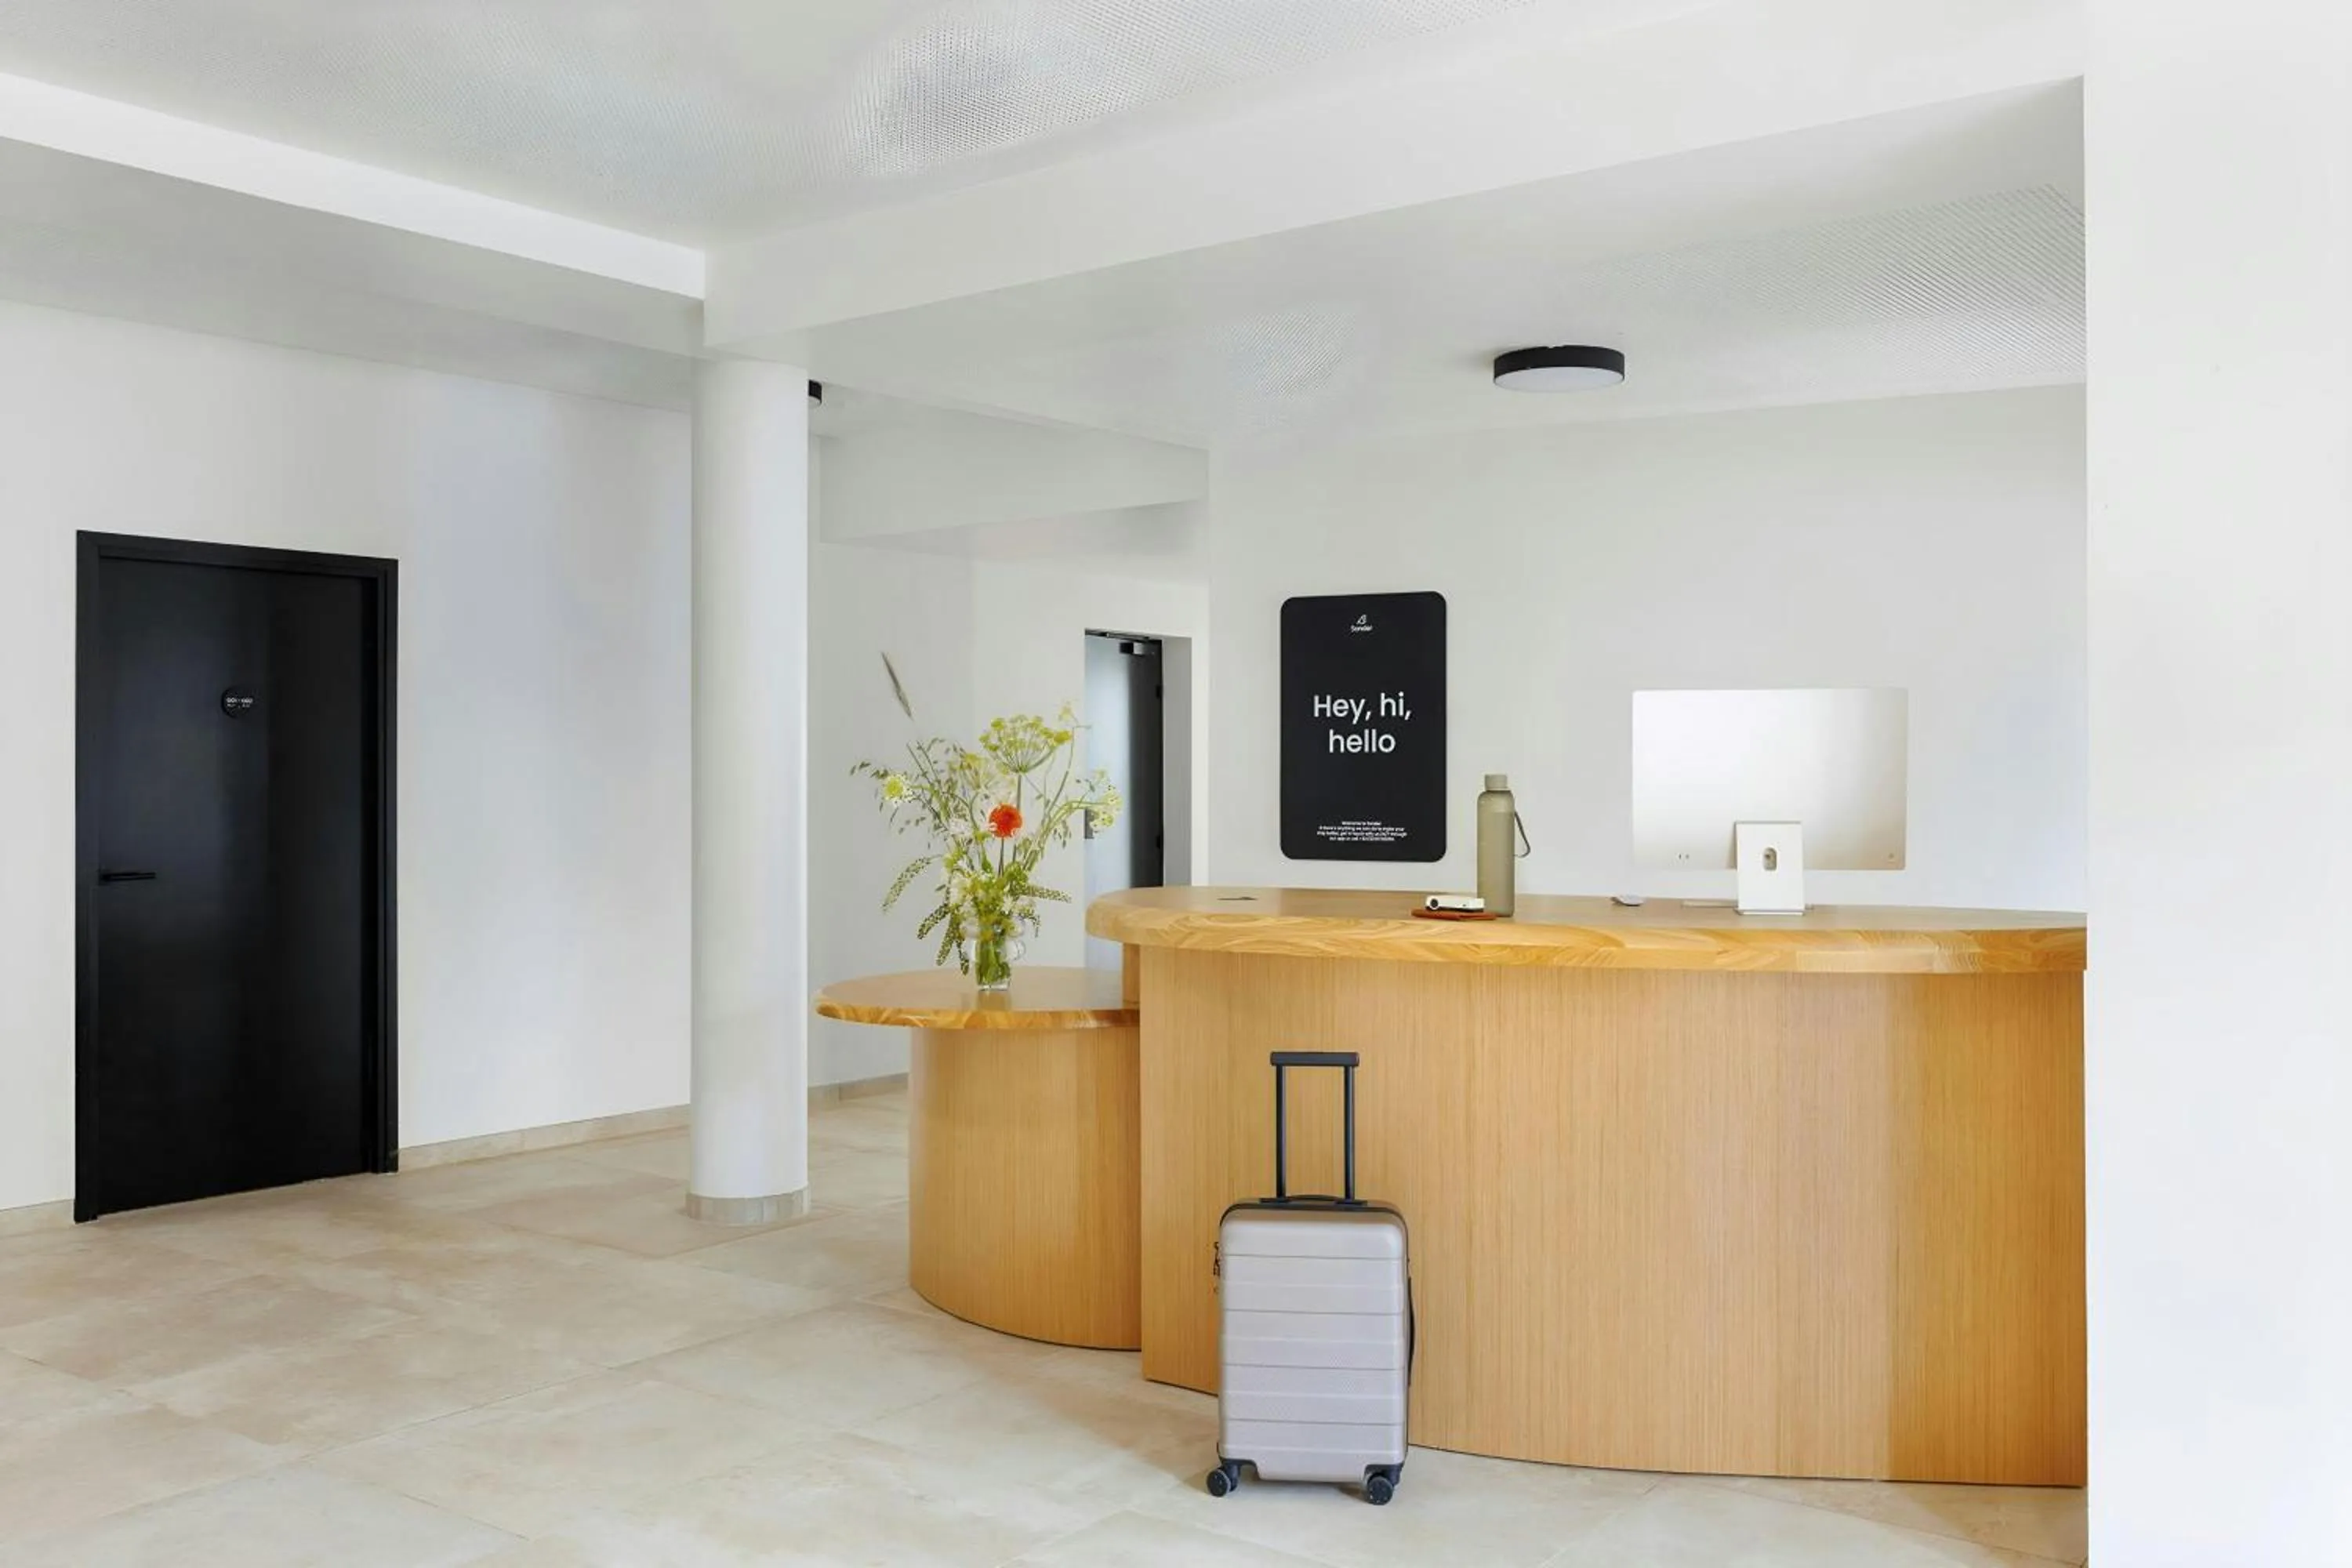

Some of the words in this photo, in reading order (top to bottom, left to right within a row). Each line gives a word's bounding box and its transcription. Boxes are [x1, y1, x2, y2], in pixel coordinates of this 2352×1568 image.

[1313, 694, 1372, 724] Hey,
[1380, 691, 1412, 720] hi,
[1329, 728, 1396, 753] hello
